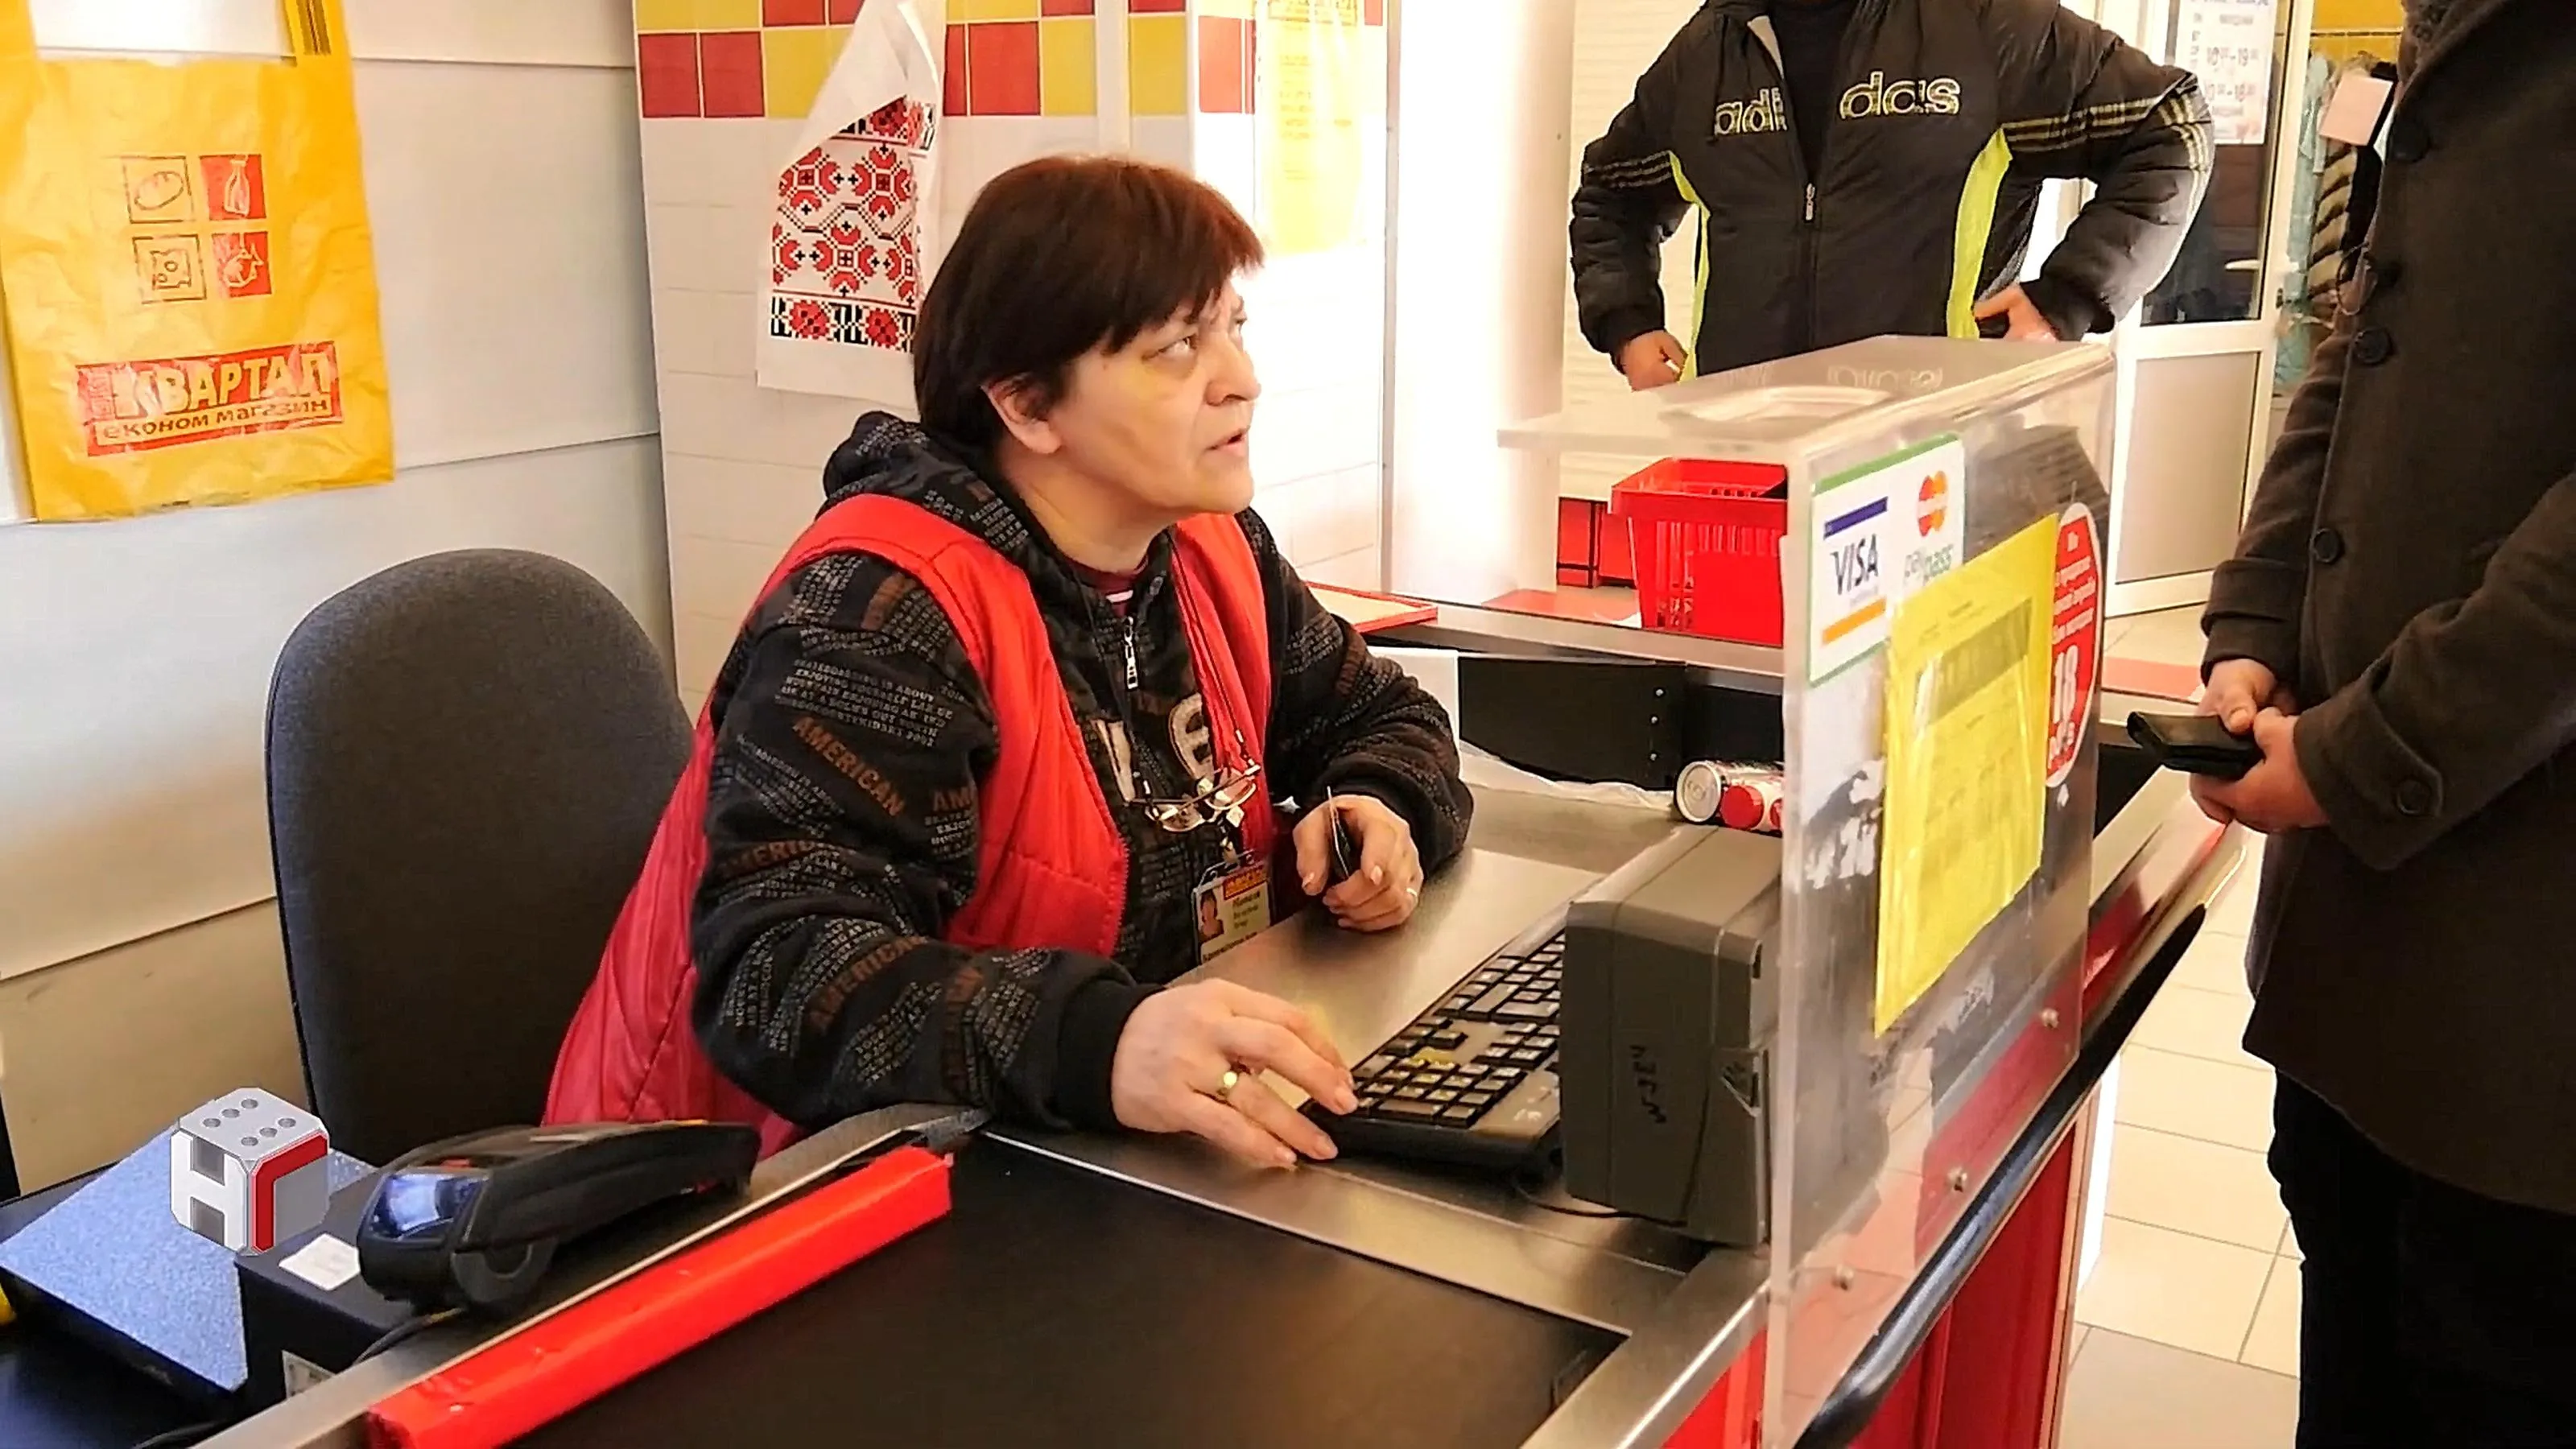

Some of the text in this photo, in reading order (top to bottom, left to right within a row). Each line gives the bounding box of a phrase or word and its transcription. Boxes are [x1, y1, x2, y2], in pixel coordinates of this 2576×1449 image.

[1839, 69, 1962, 120] das
[112, 351, 333, 419] КВАРТАЛ
[103, 398, 328, 440] економ магазин
[1830, 534, 1879, 595] VISA
[2053, 644, 2079, 724] 18
[792, 714, 906, 817] AMERICAN
